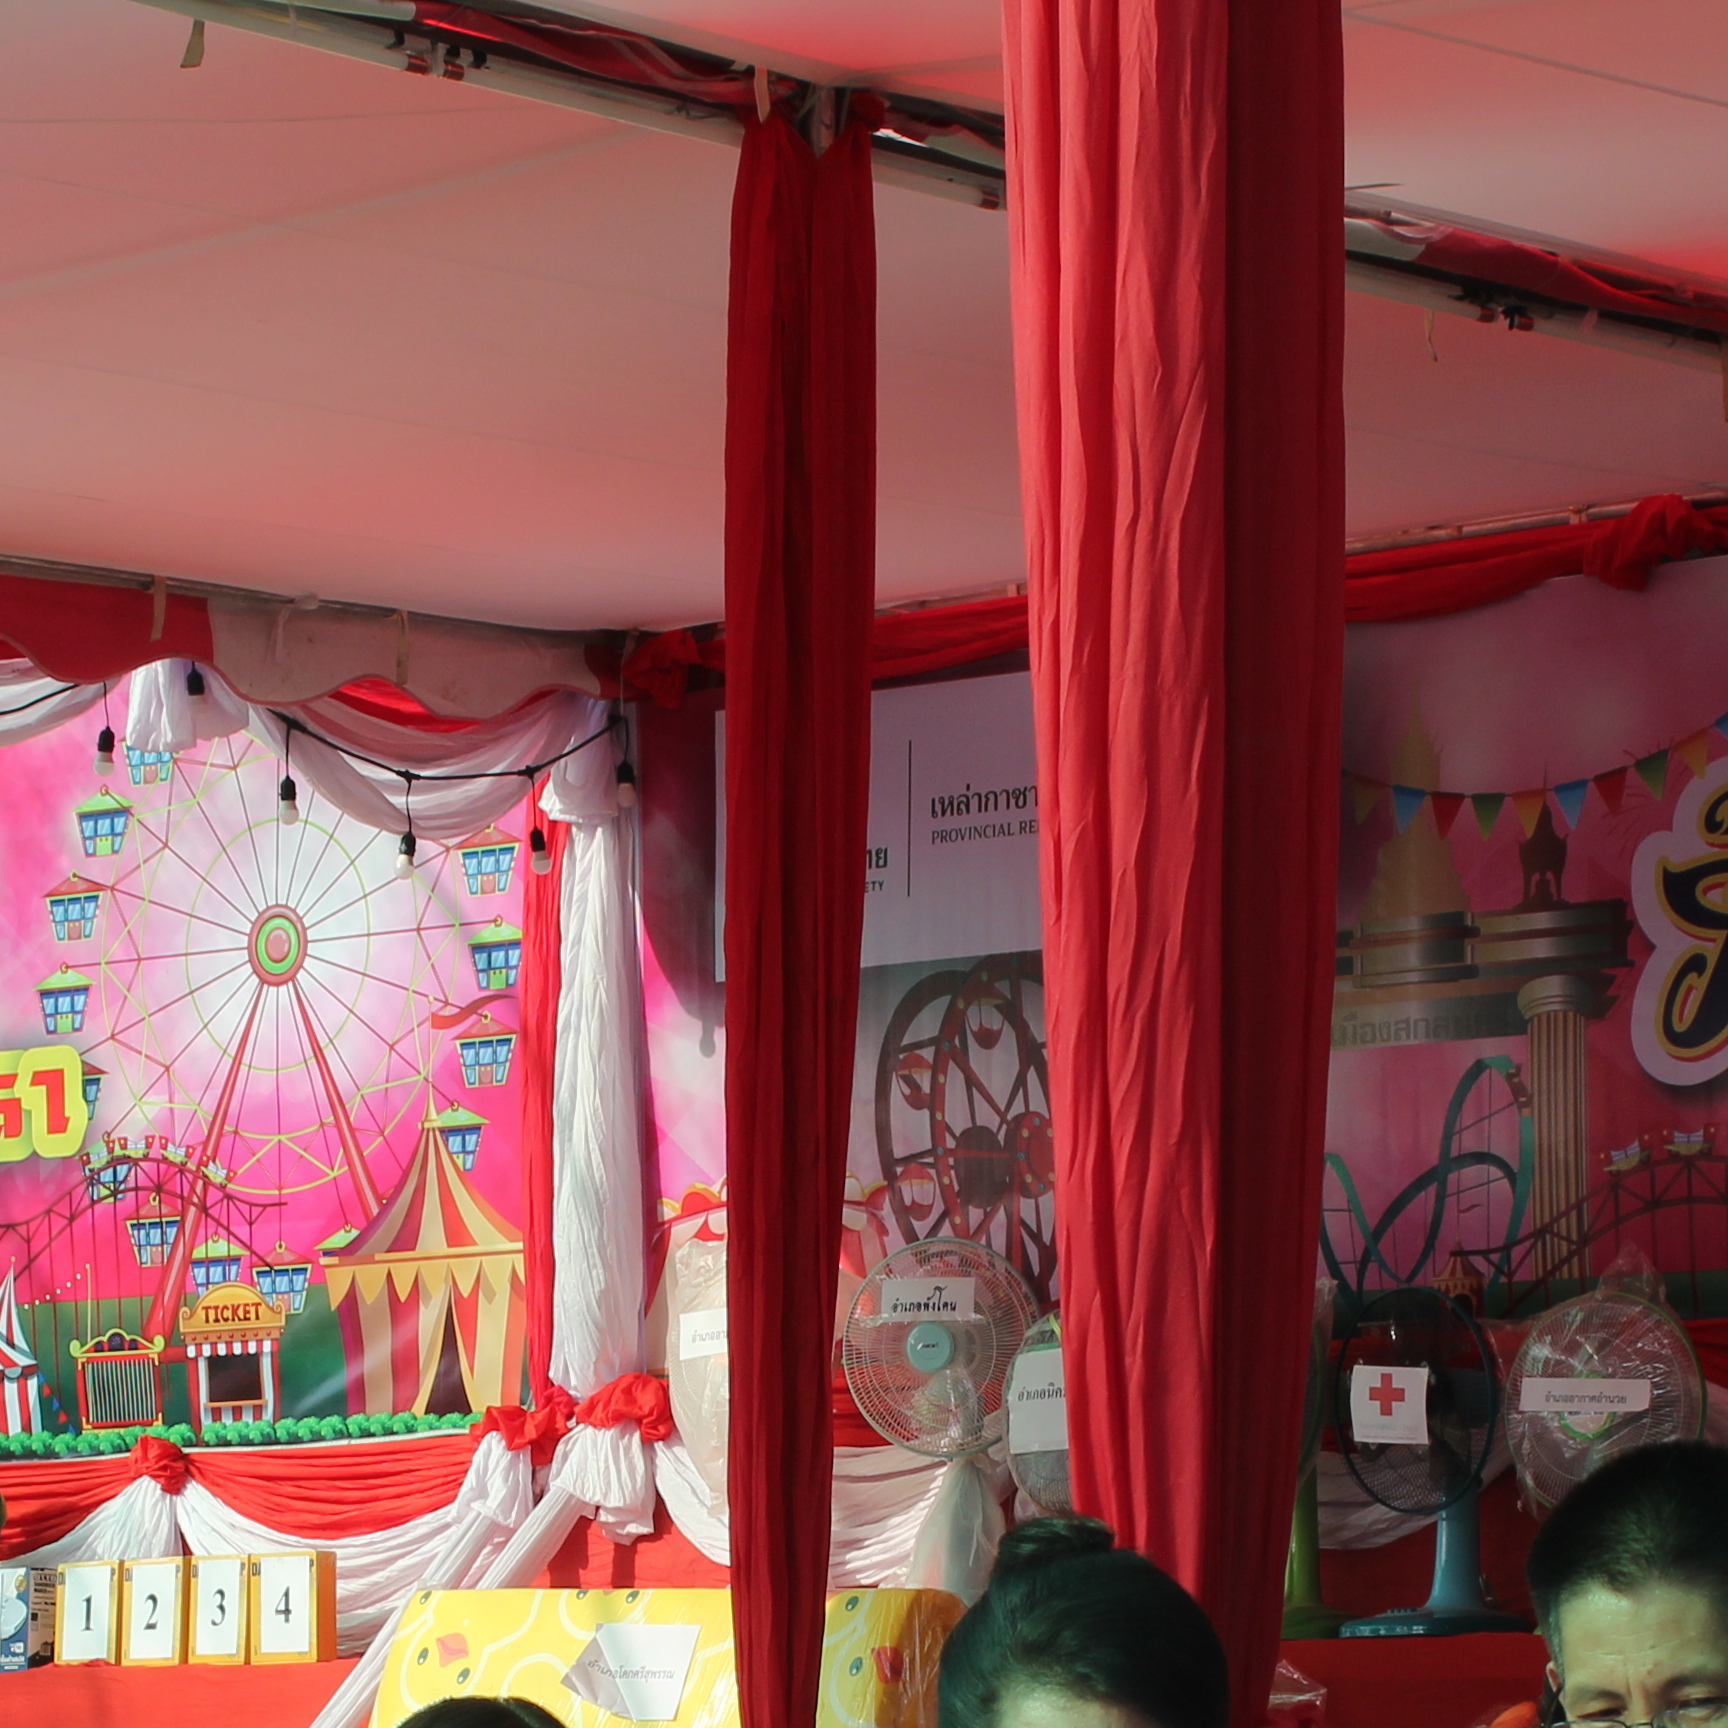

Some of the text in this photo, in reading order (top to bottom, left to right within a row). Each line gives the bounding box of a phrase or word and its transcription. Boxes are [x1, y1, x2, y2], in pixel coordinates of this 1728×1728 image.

[931, 819, 1039, 845] PROVINCIAL RE
[201, 1300, 263, 1325] TICKET
[1017, 1382, 1067, 1402] อำเภอนิค
[81, 1595, 95, 1632] 1
[143, 1593, 159, 1631] 2
[210, 1588, 227, 1627] 3
[274, 1586, 293, 1625] 4
